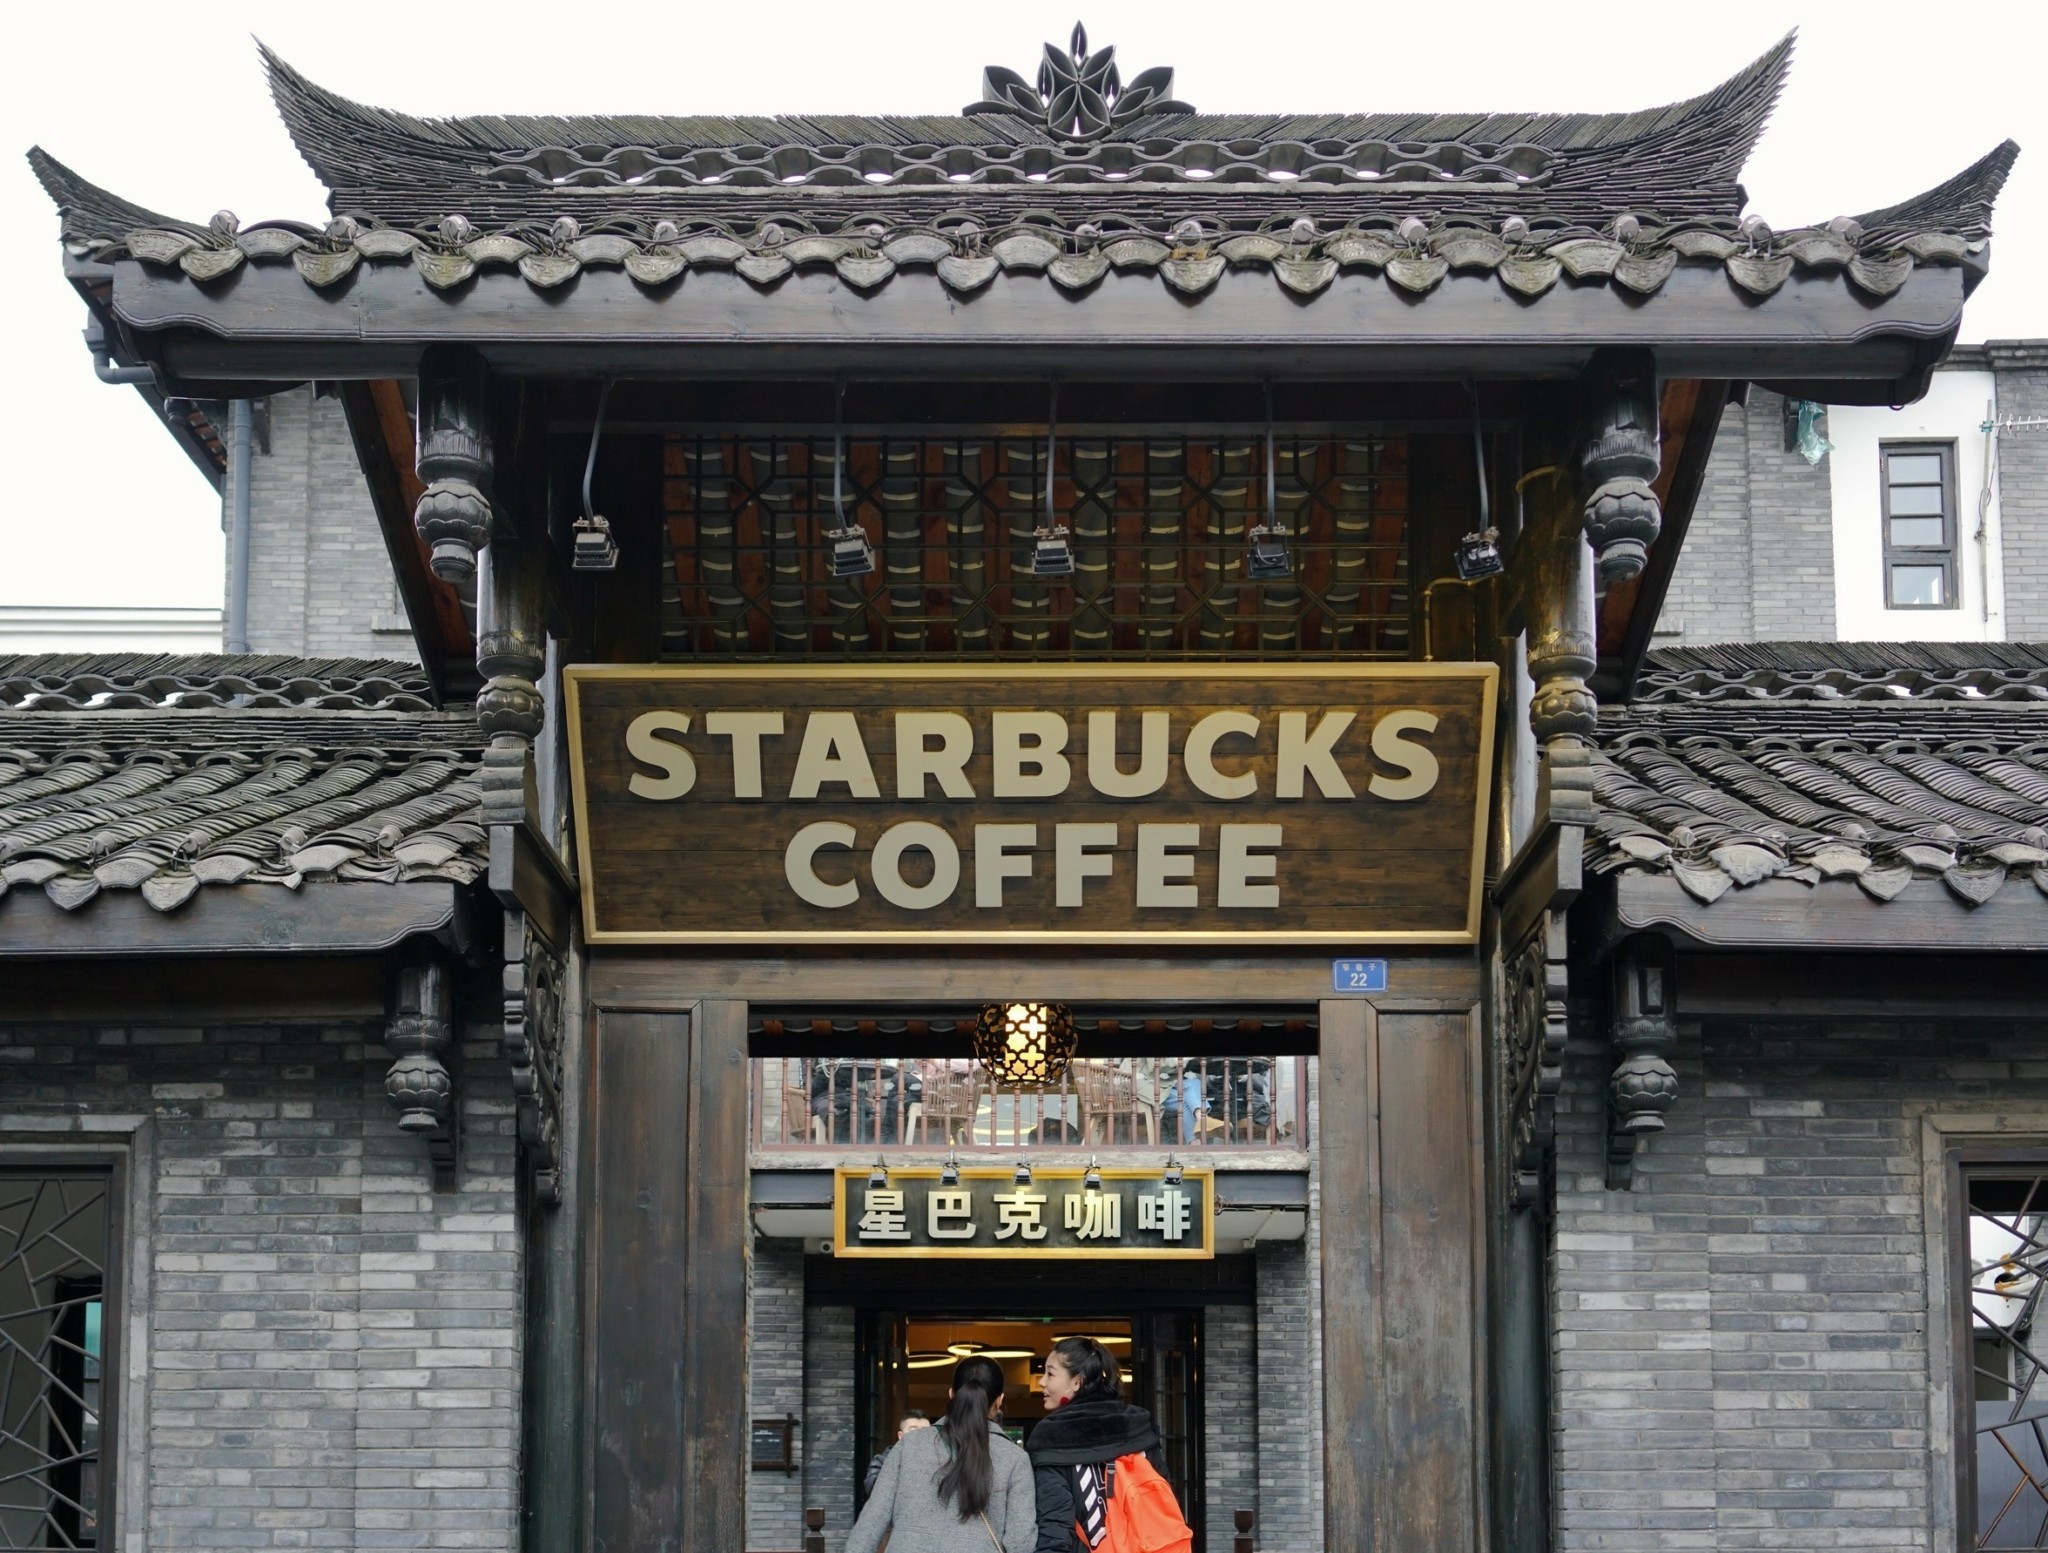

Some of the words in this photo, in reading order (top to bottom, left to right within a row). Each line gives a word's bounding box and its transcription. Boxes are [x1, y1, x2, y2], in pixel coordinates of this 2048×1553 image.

[626, 710, 1440, 801] STARBUCKS
[784, 821, 1283, 910] COFFEE
[1350, 973, 1368, 987] 22
[858, 1189, 1192, 1240] 星巴克咖啡
